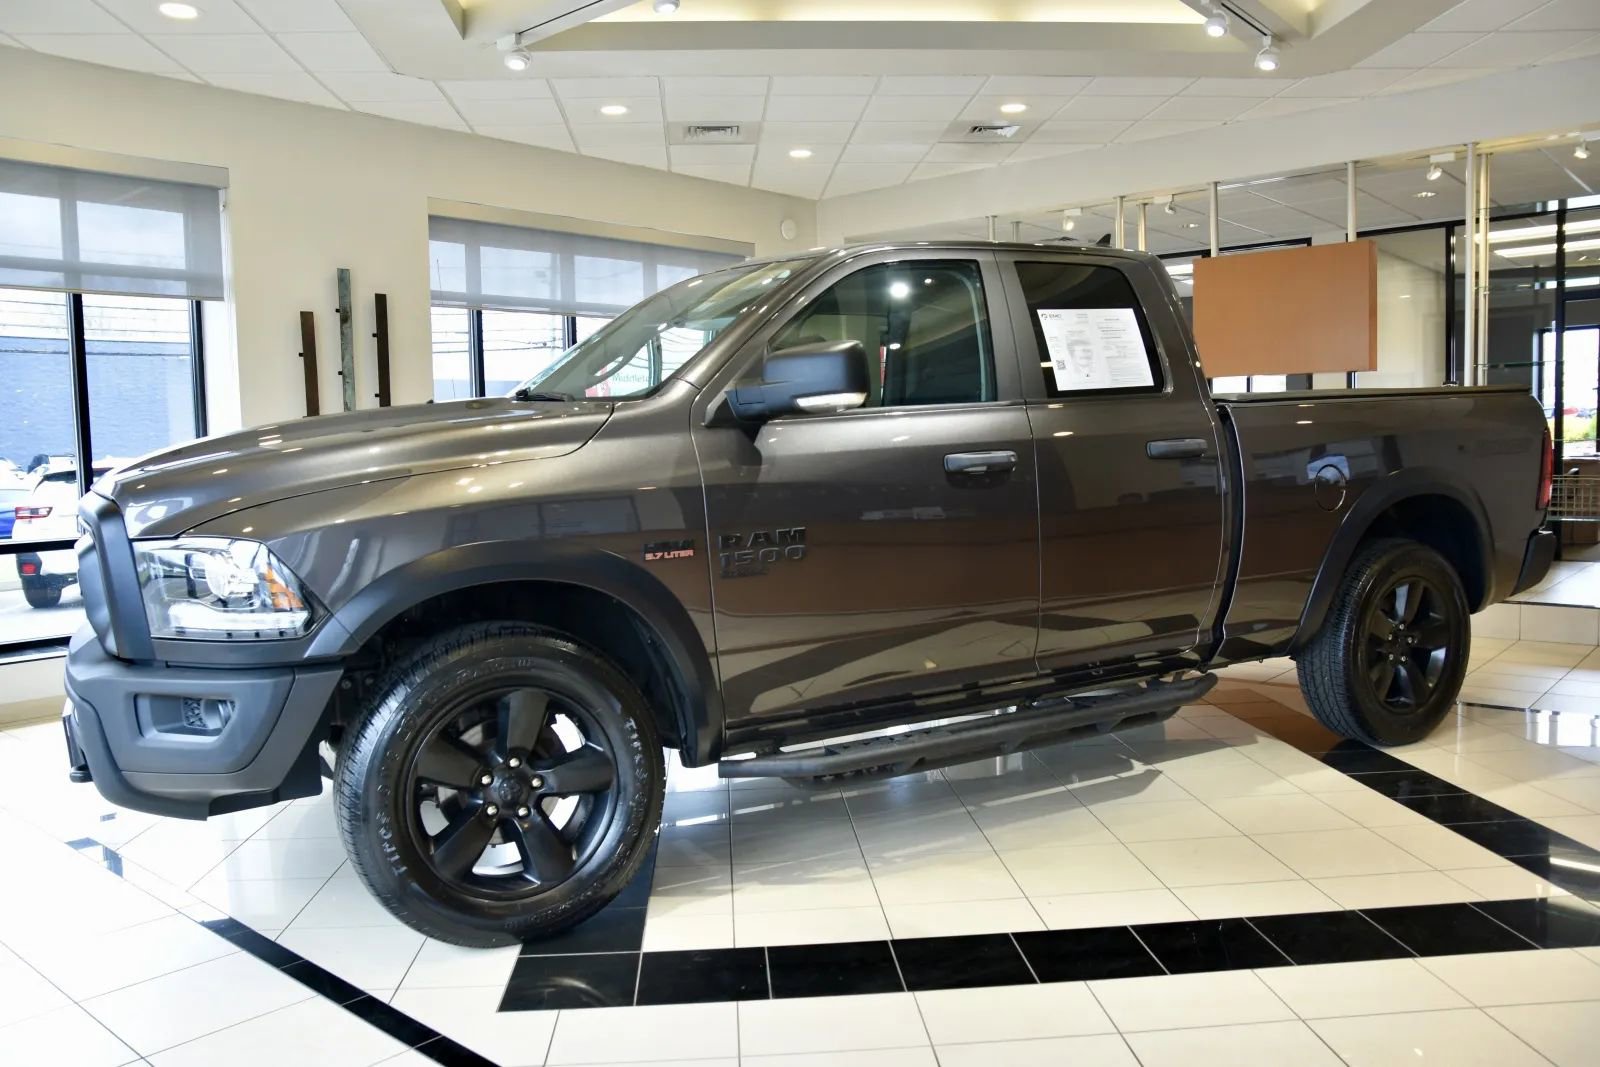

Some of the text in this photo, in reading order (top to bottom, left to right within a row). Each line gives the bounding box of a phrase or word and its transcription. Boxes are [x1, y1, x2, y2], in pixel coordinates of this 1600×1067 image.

[719, 527, 806, 550] RAM
[663, 549, 694, 559] LITER
[719, 544, 806, 567] 1500
